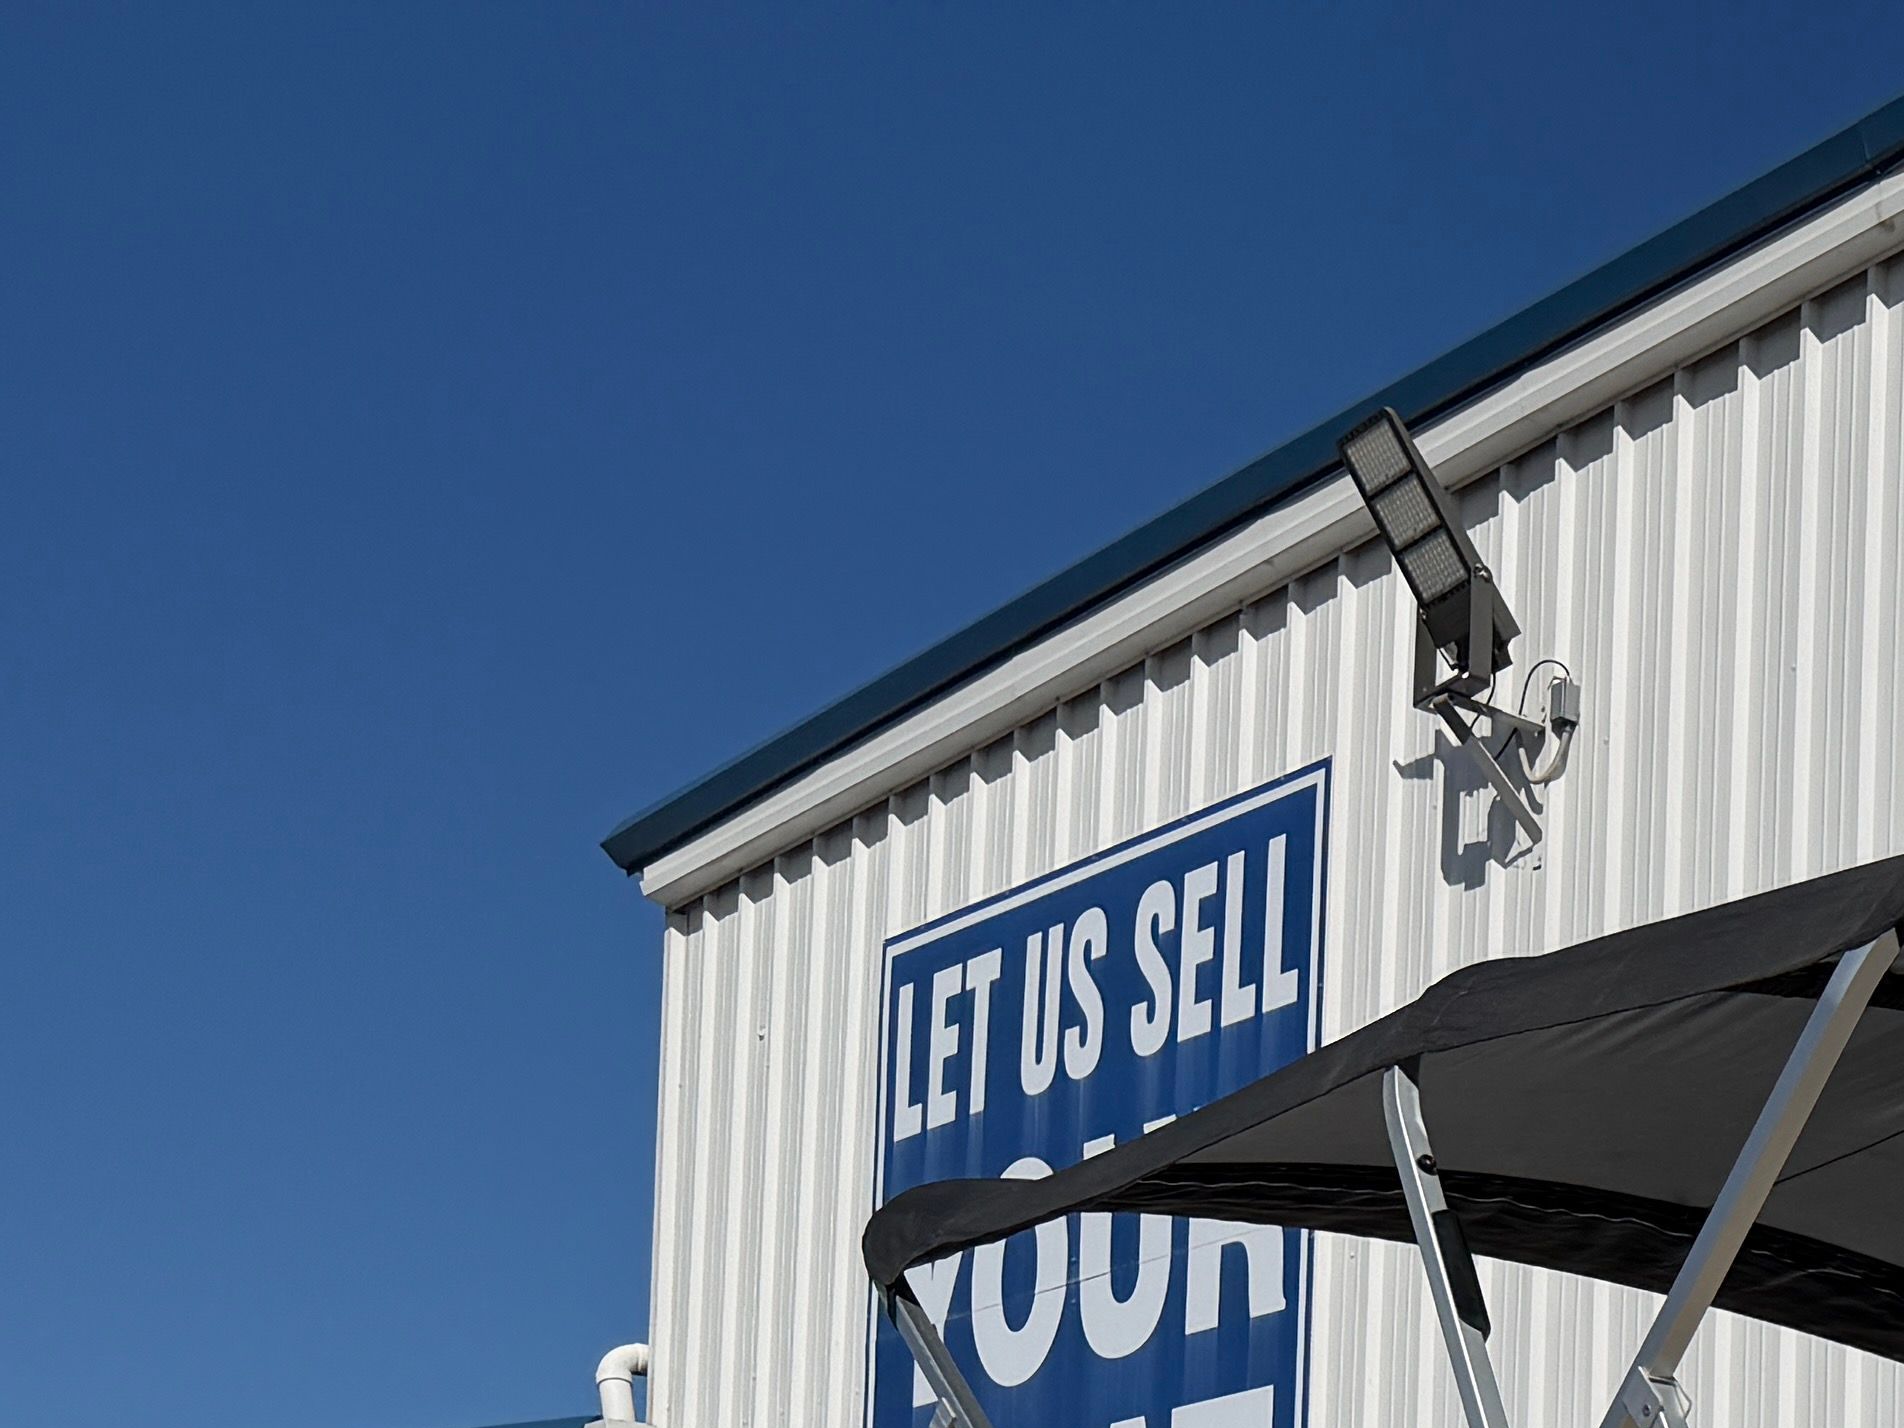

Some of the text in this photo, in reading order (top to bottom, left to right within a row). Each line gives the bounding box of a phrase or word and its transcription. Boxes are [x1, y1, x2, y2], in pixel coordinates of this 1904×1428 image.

[893, 834, 1298, 1142] LET US SELL
